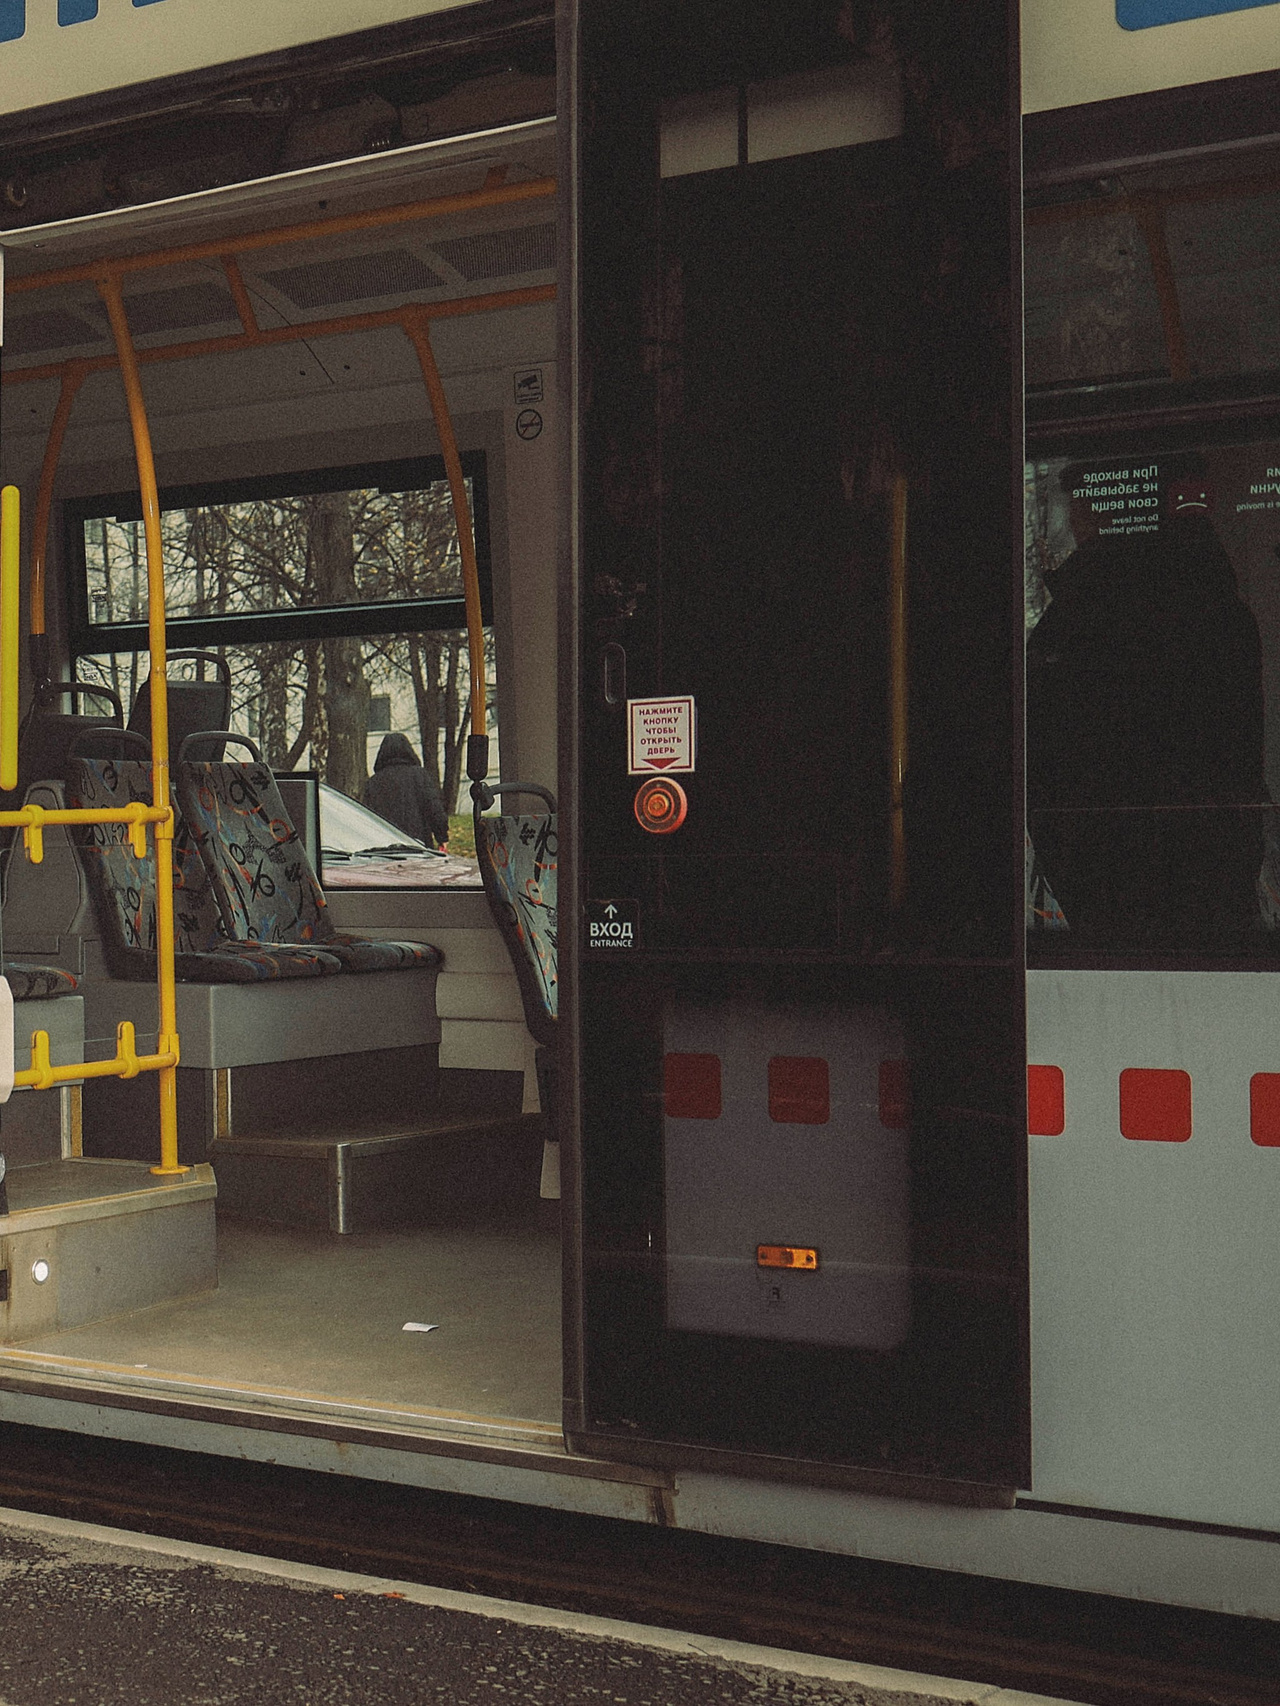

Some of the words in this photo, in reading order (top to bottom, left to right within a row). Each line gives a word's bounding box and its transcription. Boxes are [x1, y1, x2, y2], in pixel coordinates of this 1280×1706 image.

[638, 706, 683, 716] НАЖМИТЕ
[643, 716, 679, 726] КНОПКУ
[645, 726, 677, 735] ЧТОБЫ
[640, 736, 683, 746] ОТКРЫТЬ
[647, 747, 675, 756] ДВЕРЬ
[590, 922, 634, 939] ВХОД
[590, 940, 633, 948] ENTRANCE
